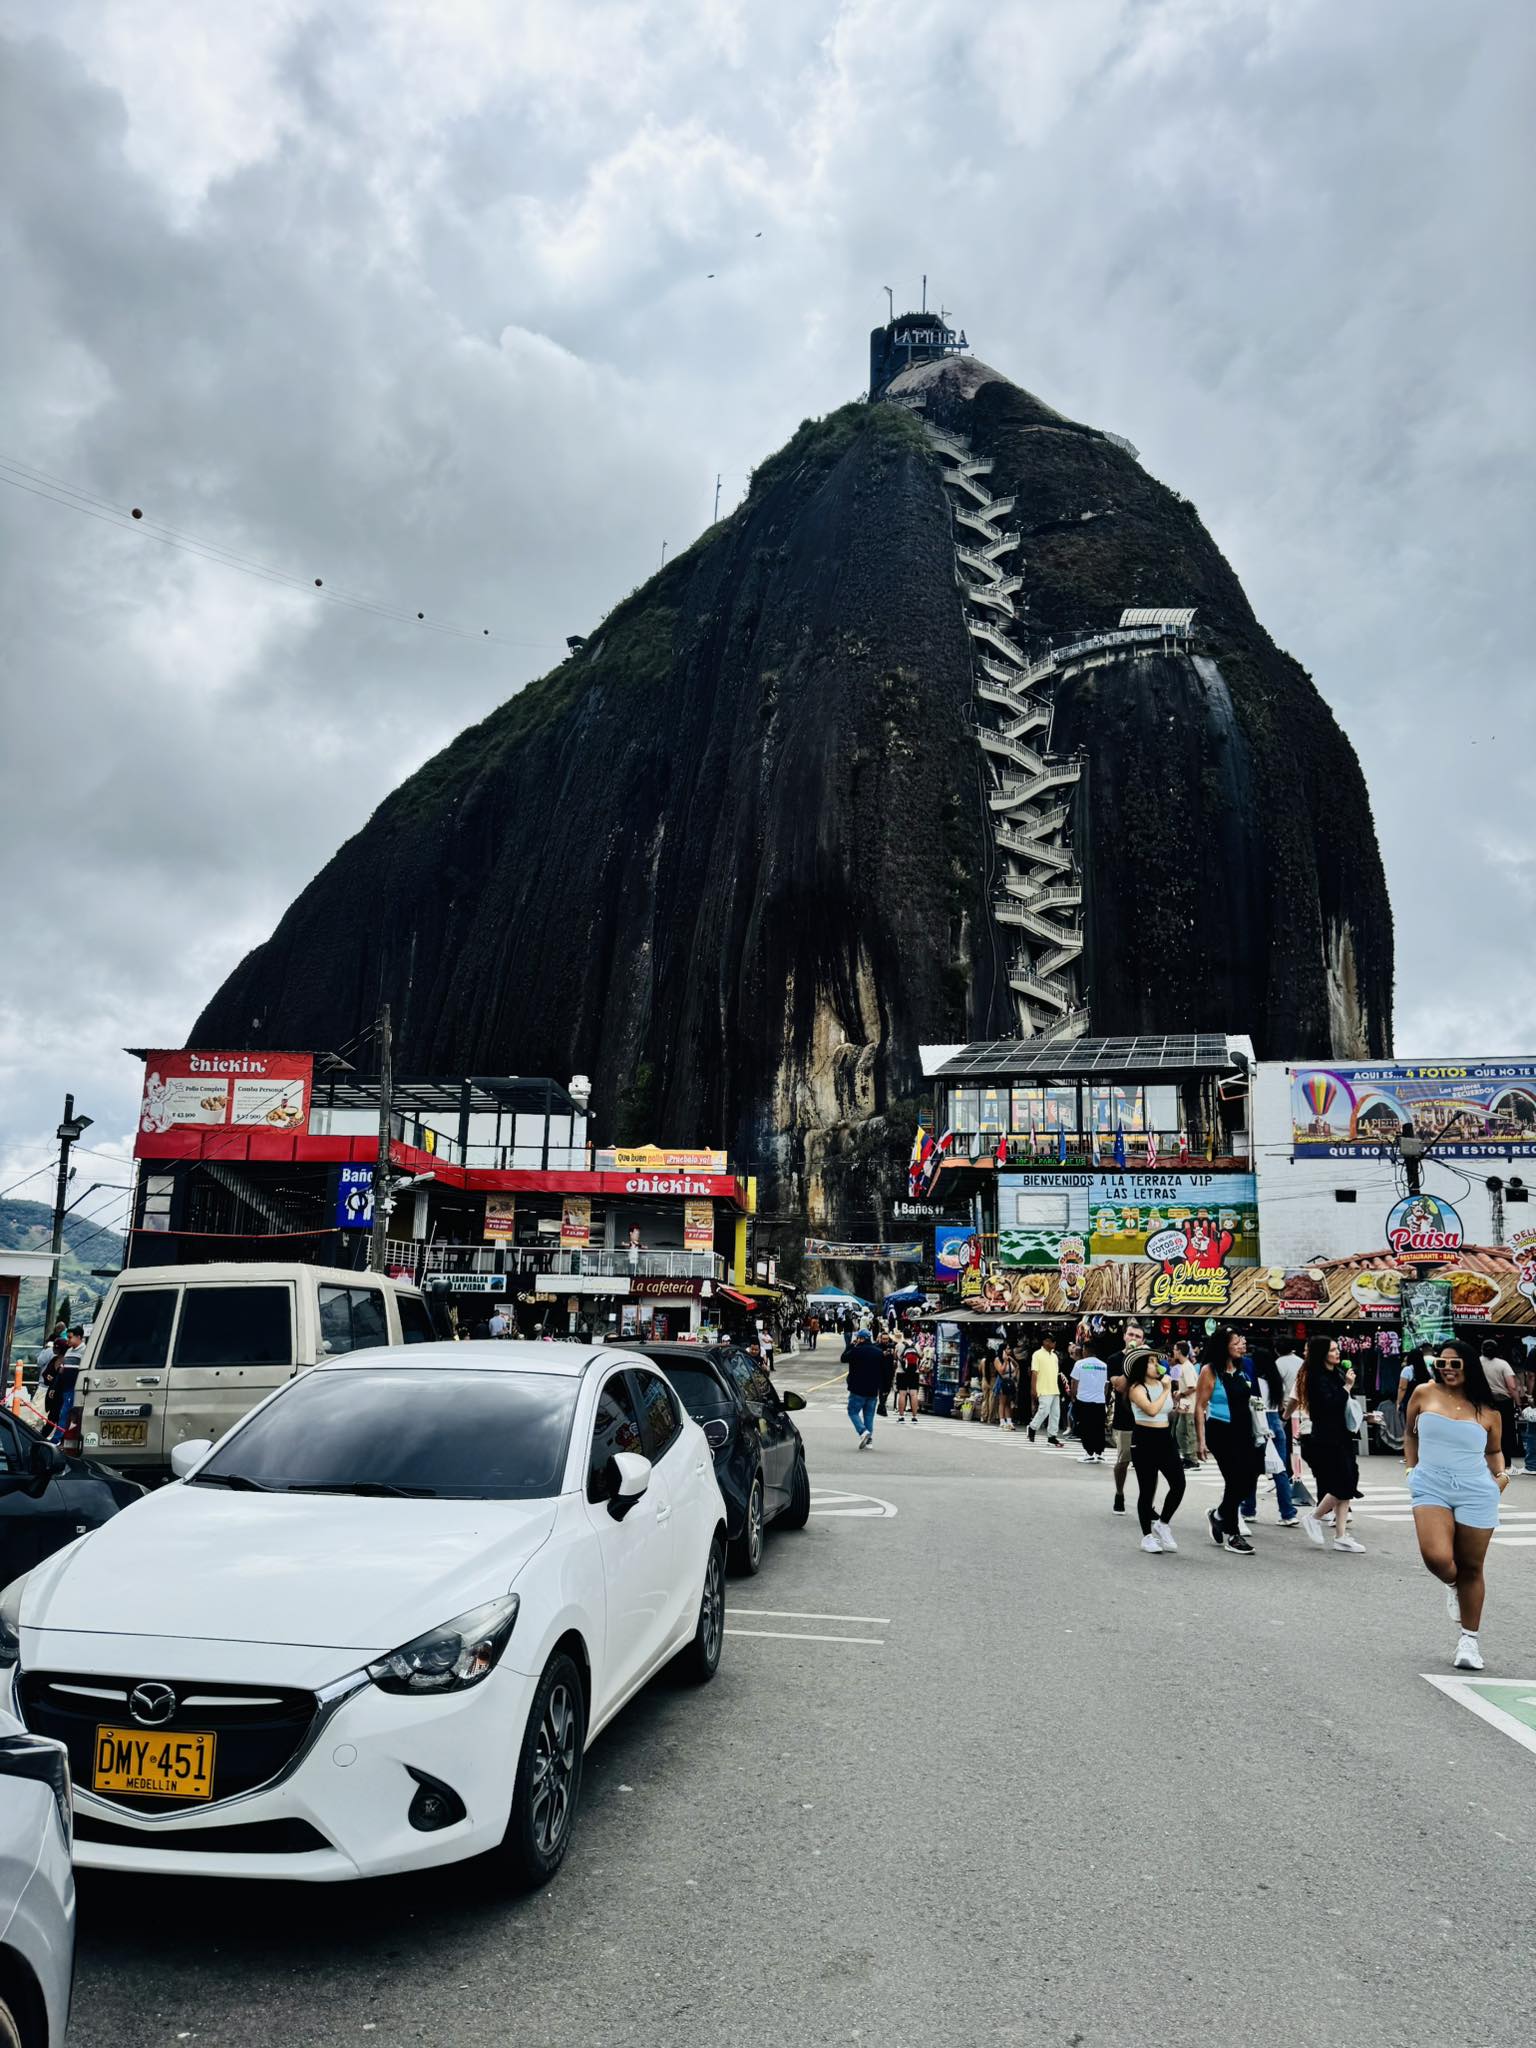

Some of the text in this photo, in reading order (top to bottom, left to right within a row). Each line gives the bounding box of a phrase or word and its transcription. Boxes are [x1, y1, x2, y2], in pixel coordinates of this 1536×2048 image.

[1354, 1071, 1380, 1080] AQUI
[1406, 1069, 1415, 1079] 4
[1419, 1067, 1467, 1078] FOTOS
[1475, 1068, 1496, 1077] QUE
[1499, 1068, 1515, 1076] NO
[1519, 1068, 1531, 1076] TE
[1329, 1147, 1356, 1156] QUE
[1362, 1147, 1380, 1156] NO
[1462, 1146, 1506, 1155] ESTOS
[618, 1154, 630, 1162] Que
[631, 1154, 647, 1162] buen
[342, 1168, 373, 1183] Baño
[1023, 1175, 1213, 1187] BIENVENIDOS A LA TERRAZA VIP
[1106, 1188, 1177, 1200] LAS LETRAS
[901, 1202, 934, 1215] Baños
[1390, 1228, 1461, 1251] Paisa
[1152, 1239, 1175, 1255] FOTOS
[1400, 1253, 1438, 1261] RESTAURANTE
[1173, 1261, 1228, 1283] Mano
[452, 1275, 488, 1283] ESMERALDA
[462, 1283, 486, 1291] PIEDRA
[631, 1280, 694, 1296] La cafetería
[1151, 1274, 1230, 1305] Gigante
[101, 1408, 124, 1416] TOYOTA
[126, 1778, 178, 1792] MEDELLIN
